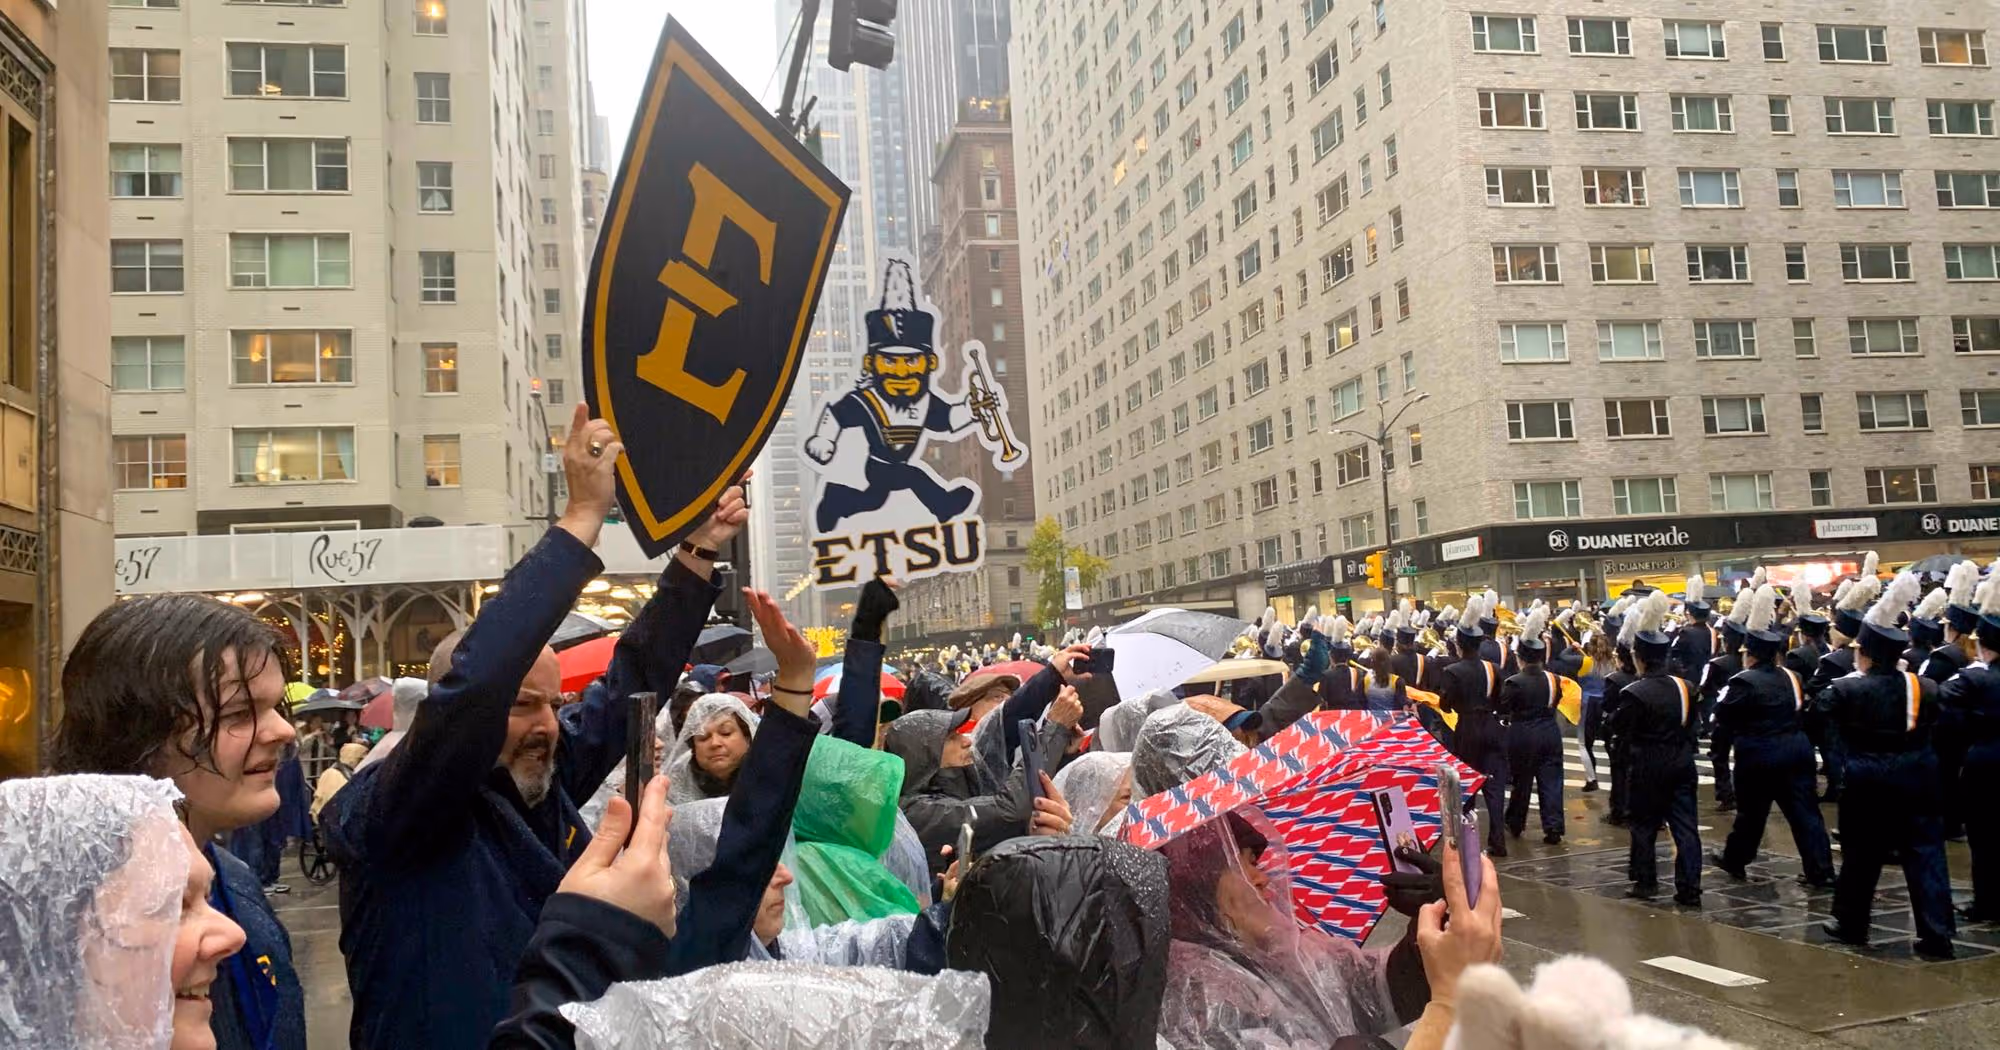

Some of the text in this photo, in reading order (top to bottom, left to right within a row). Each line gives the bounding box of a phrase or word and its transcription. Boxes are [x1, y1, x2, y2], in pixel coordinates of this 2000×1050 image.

[1822, 521, 1871, 537] pharmacy
[1947, 517, 2000, 532] DUANE
[1549, 526, 1690, 550] DR DUANEreade
[812, 520, 980, 585] ETSU
[115, 547, 162, 592] e57
